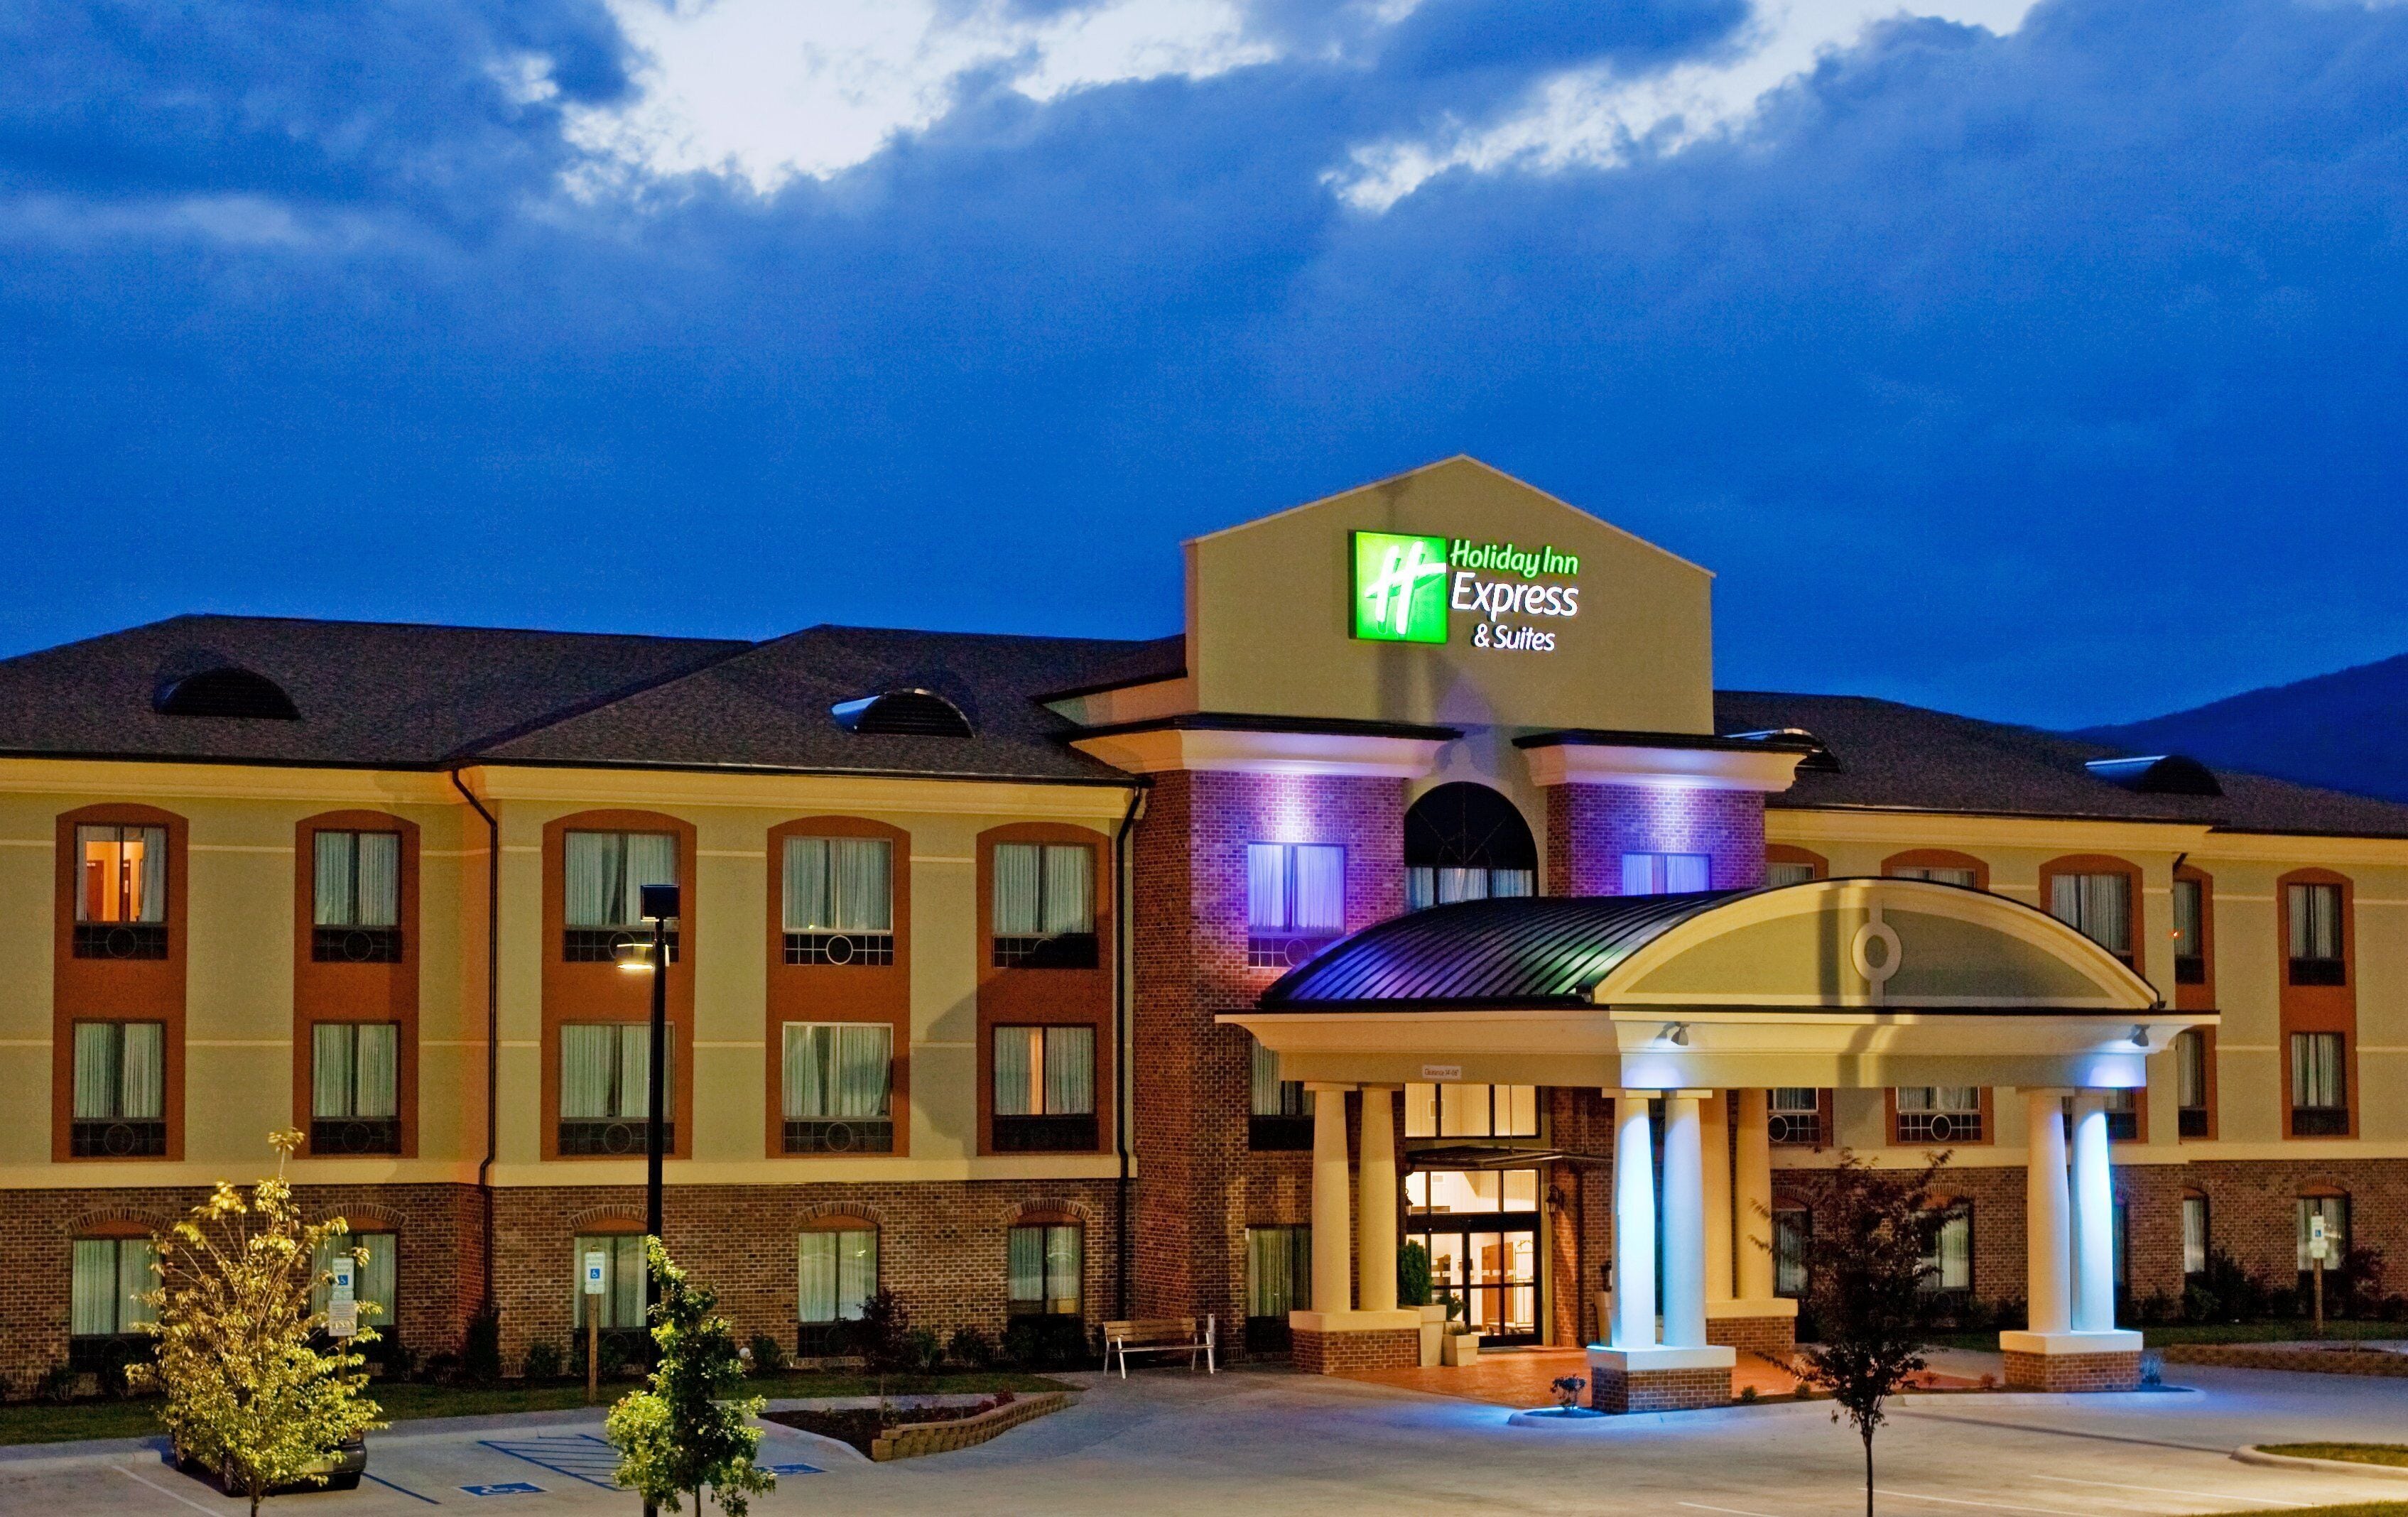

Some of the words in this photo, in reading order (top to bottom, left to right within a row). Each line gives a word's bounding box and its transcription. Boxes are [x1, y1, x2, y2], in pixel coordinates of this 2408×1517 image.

[1450, 539, 1539, 578] Holiday
[1542, 545, 1578, 575] Inn
[1450, 571, 1579, 622] Express
[1473, 623, 1489, 648] &
[1493, 625, 1555, 651] Suites
